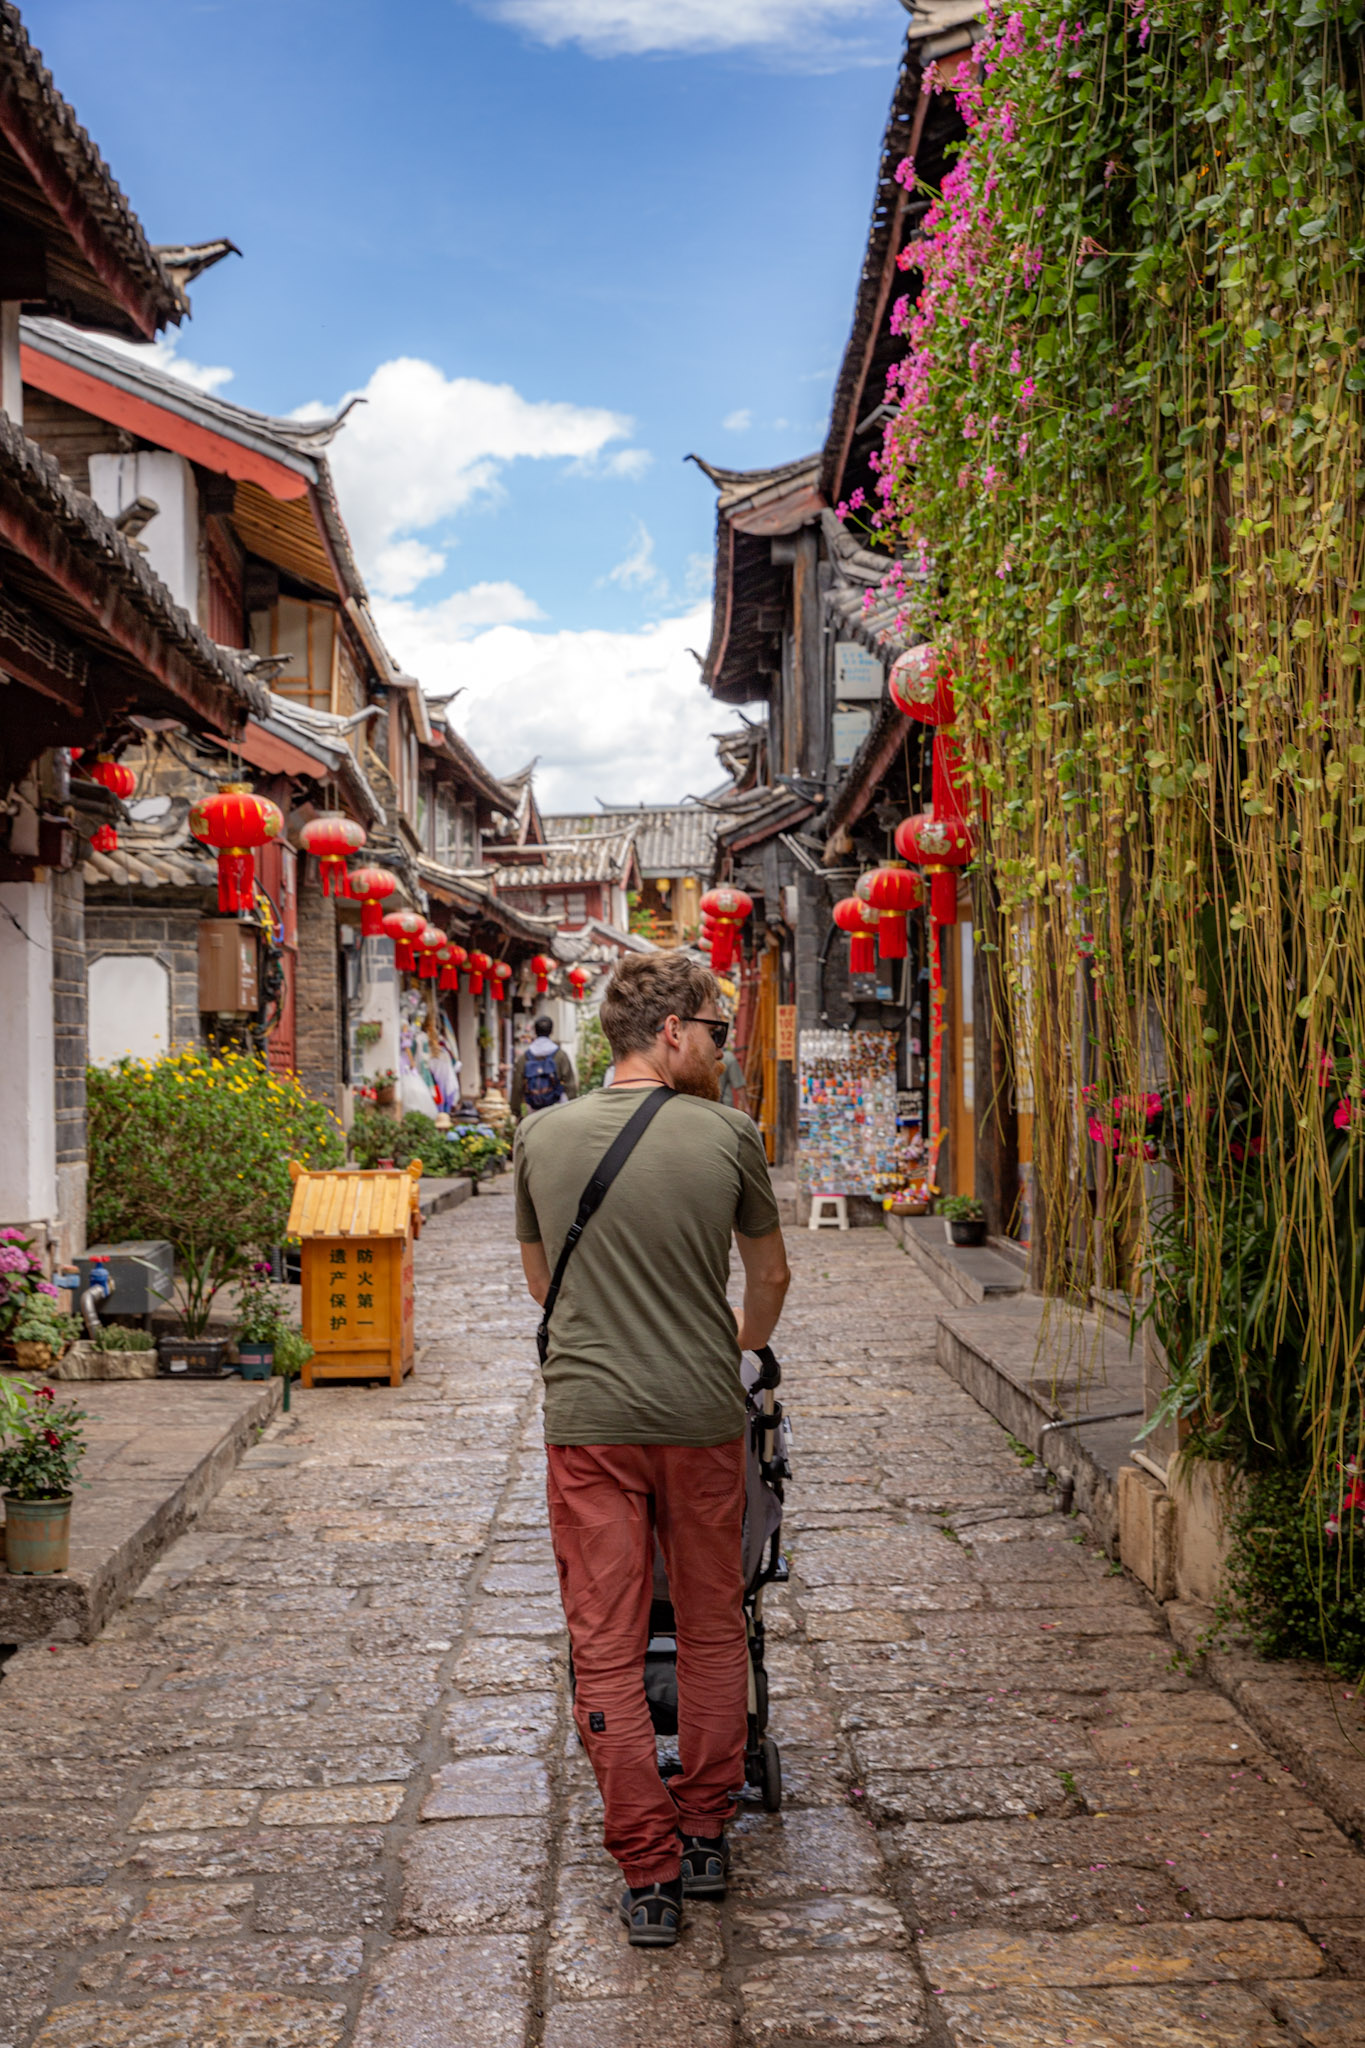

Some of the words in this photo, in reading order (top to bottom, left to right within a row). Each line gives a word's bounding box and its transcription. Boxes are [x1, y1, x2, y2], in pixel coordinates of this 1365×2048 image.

[329, 1248, 347, 1331] 遗产保护
[357, 1248, 374, 1326] 防火第一
